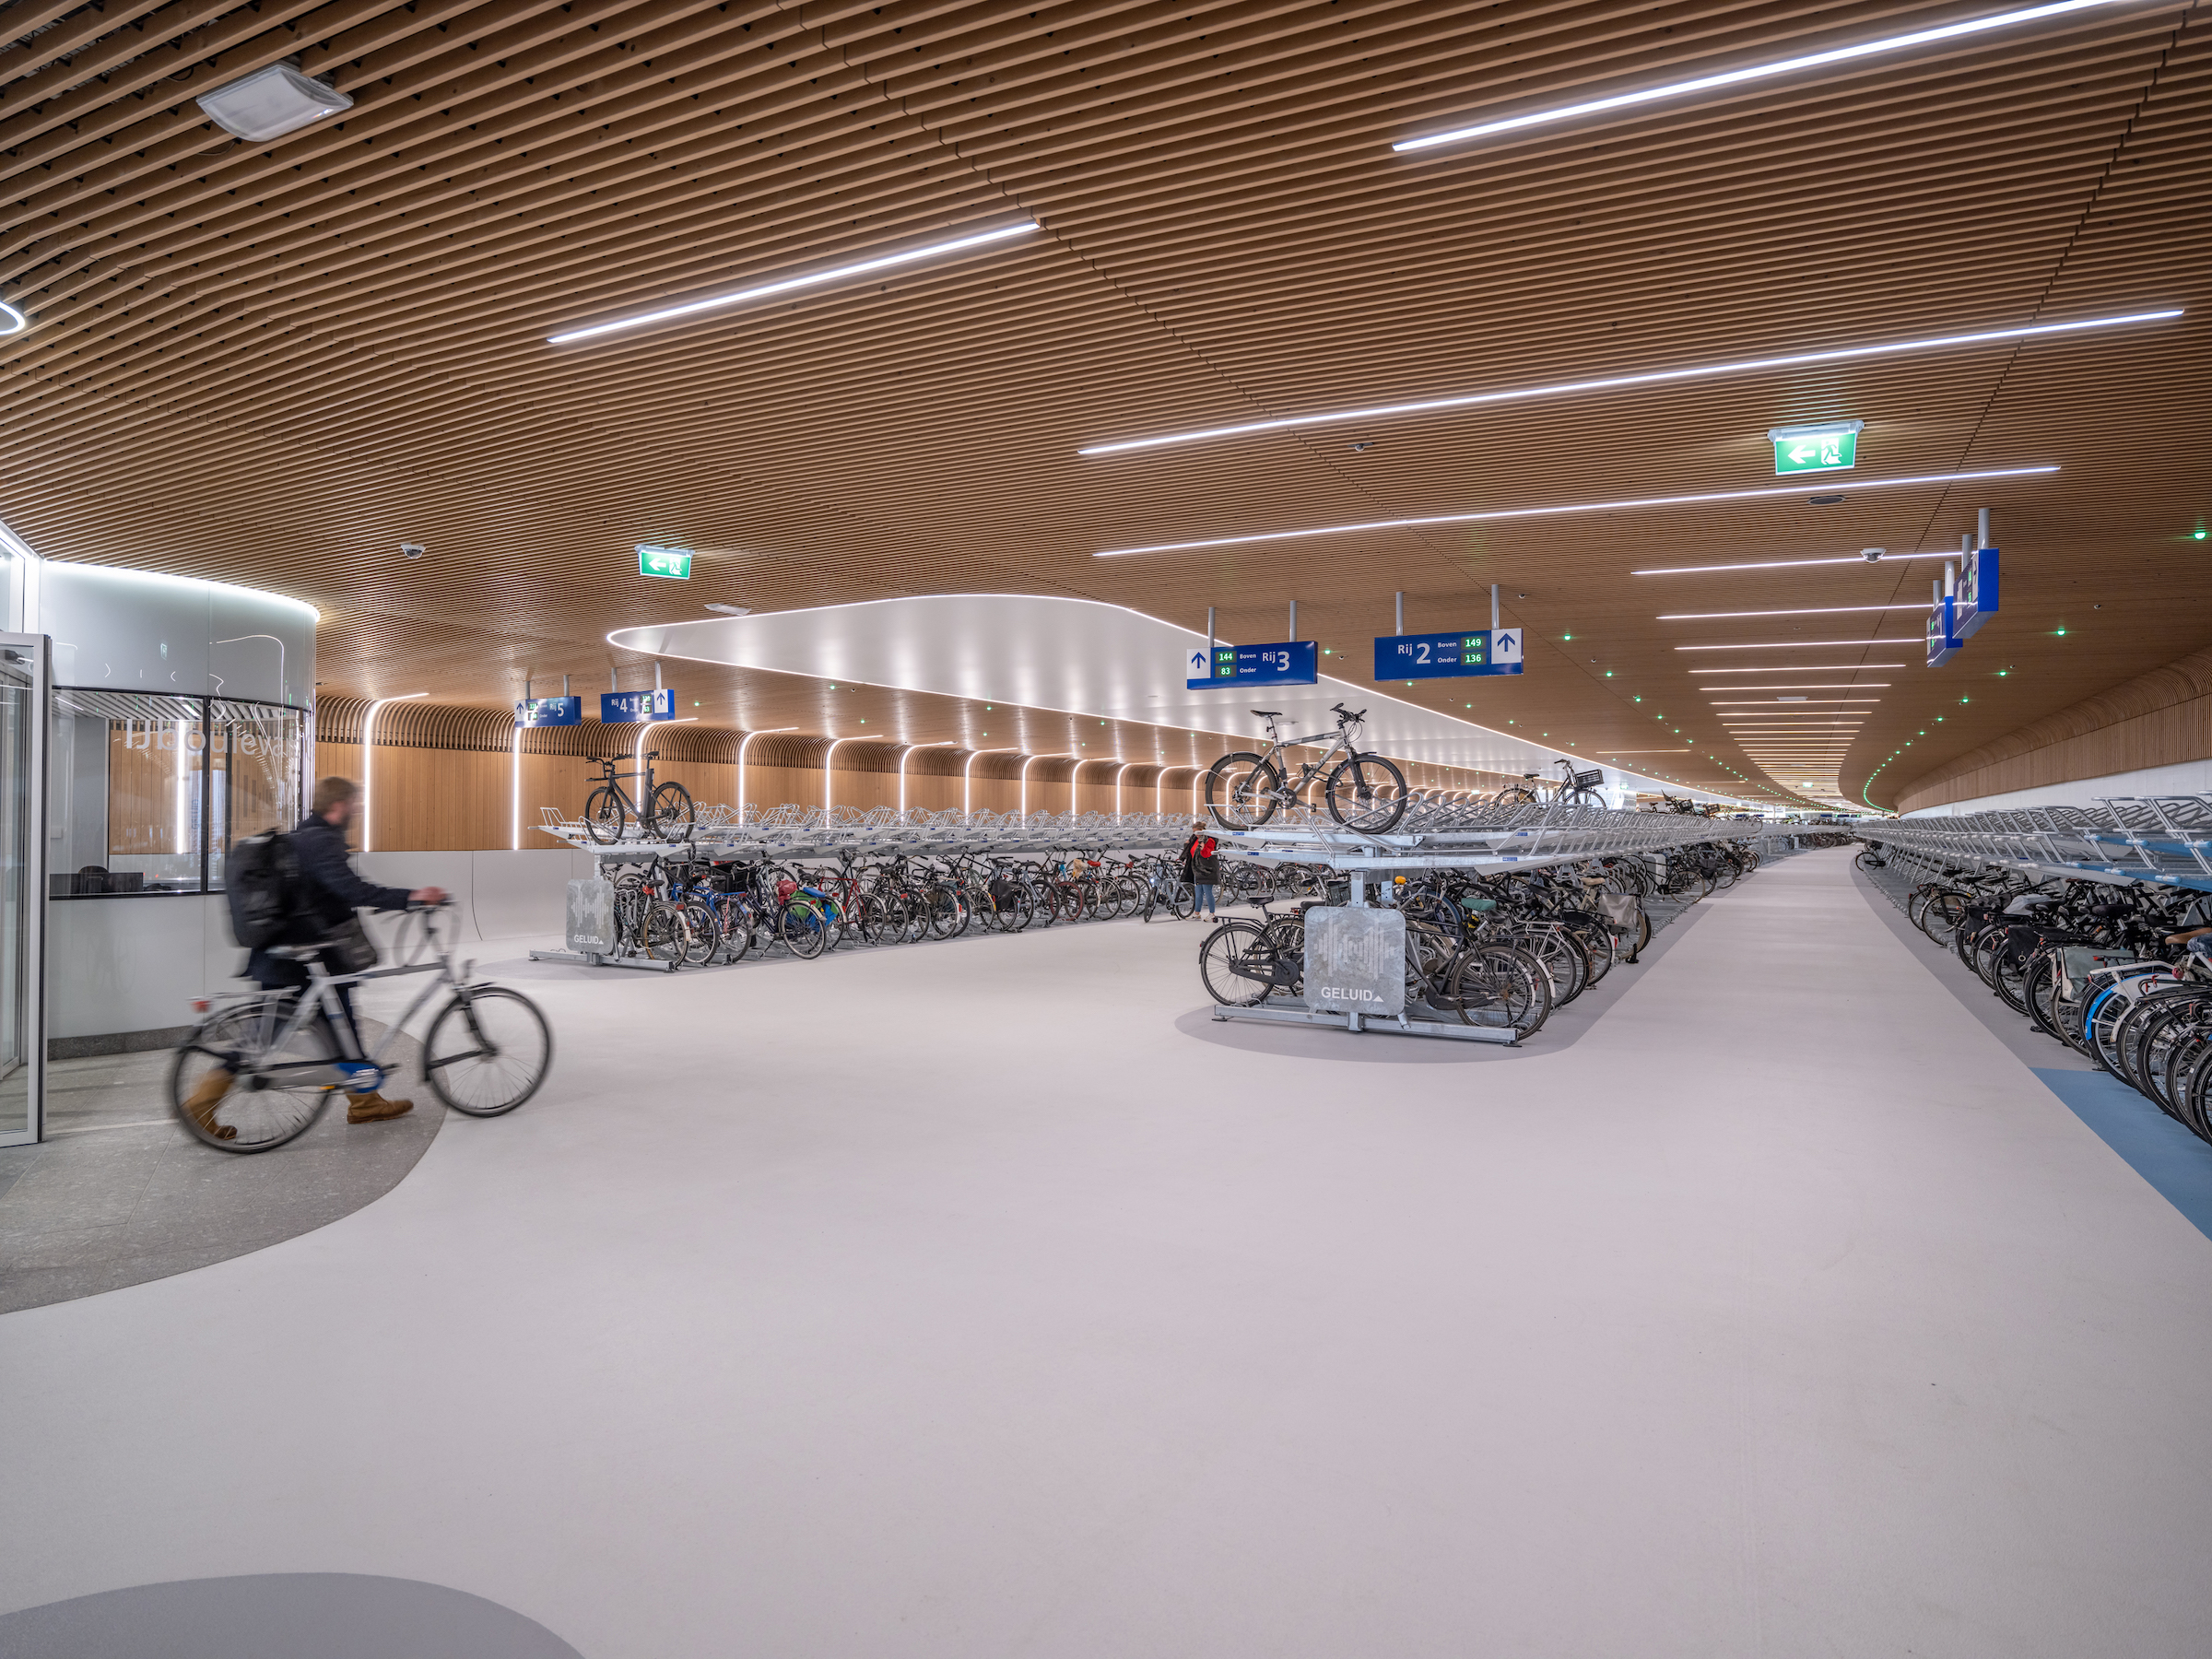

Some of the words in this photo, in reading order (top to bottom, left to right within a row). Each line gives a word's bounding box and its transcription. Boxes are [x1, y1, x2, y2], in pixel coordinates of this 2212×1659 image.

[1465, 638, 1482, 647] 149
[1218, 653, 1233, 661] 144
[1397, 643, 1413, 656] Rij
[1416, 642, 1431, 665] 2
[1465, 653, 1482, 663] 136
[1262, 651, 1277, 664] Rij
[1277, 651, 1290, 672] 3
[1220, 667, 1231, 676] 83
[557, 702, 565, 717] 5
[611, 698, 619, 707] Rij
[619, 698, 629, 712] 4
[573, 934, 599, 945] GELUID
[1321, 986, 1373, 1002] GELUID
